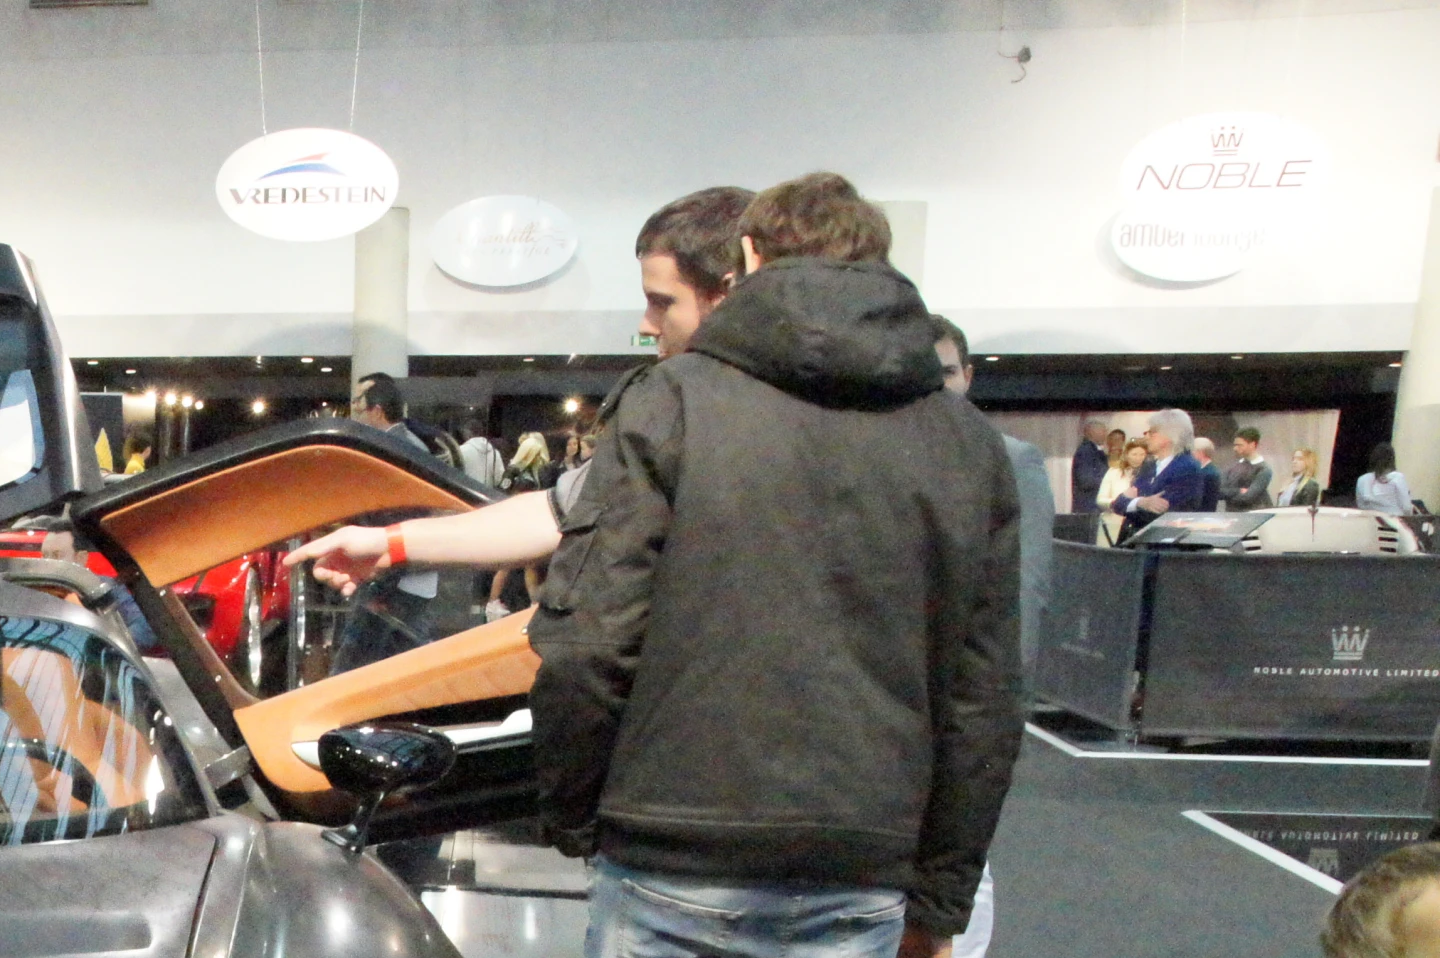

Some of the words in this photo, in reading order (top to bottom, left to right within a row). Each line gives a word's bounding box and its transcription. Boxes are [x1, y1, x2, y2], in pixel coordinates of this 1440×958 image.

[1136, 160, 1313, 190] NOBLE
[228, 186, 387, 205] VREDESTEIN
[1253, 666, 1294, 676] NOBLE
[1299, 667, 1380, 678] AUTOMOTIVE
[1386, 668, 1440, 678] LIMITED
